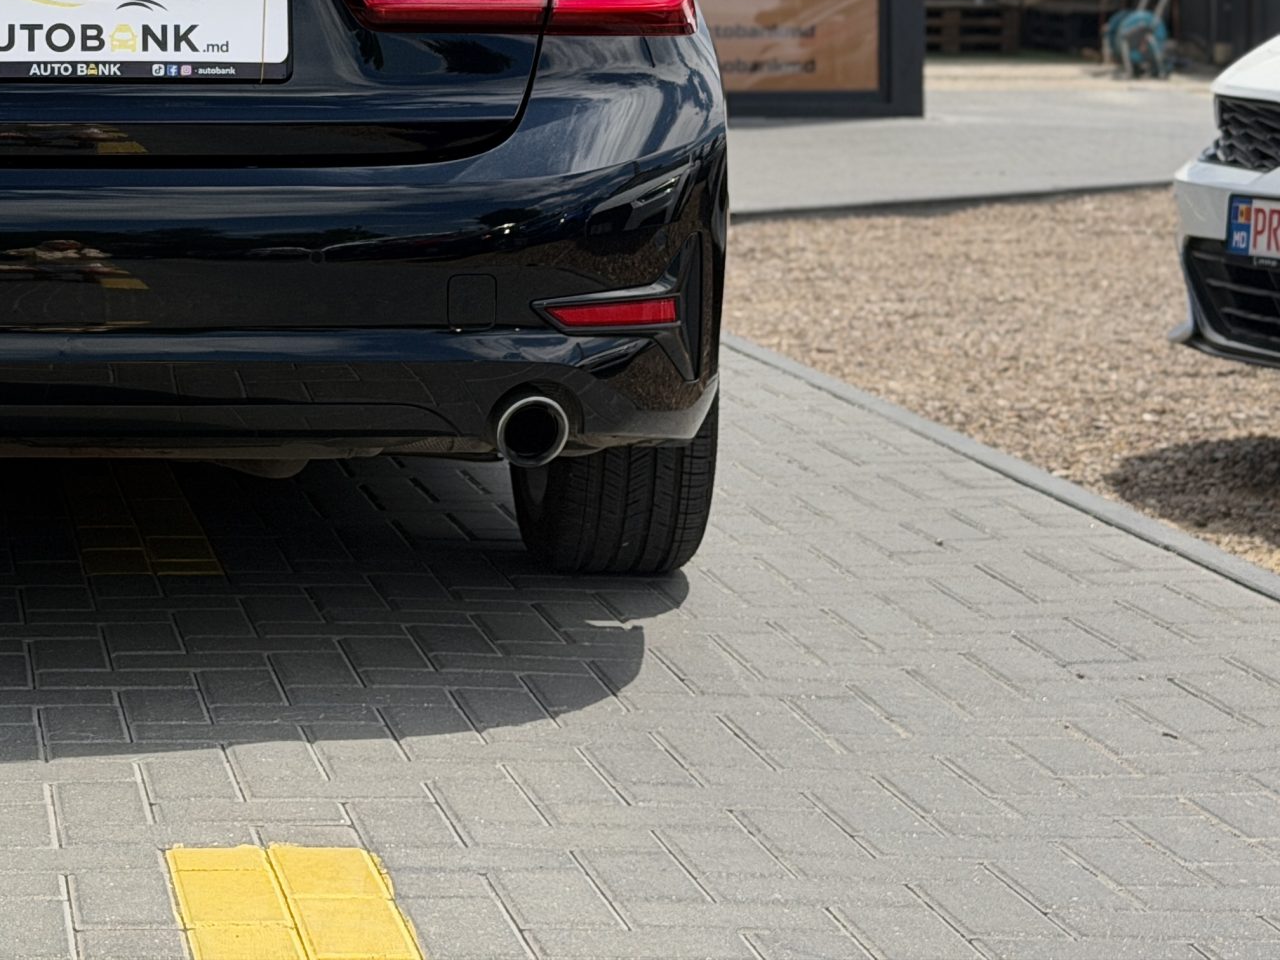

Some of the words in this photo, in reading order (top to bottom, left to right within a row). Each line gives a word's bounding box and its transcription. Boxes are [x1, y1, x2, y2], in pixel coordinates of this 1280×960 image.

[29, 64, 73, 76] AUTO
[198, 66, 236, 75] autobank
[1232, 230, 1248, 249] MD
